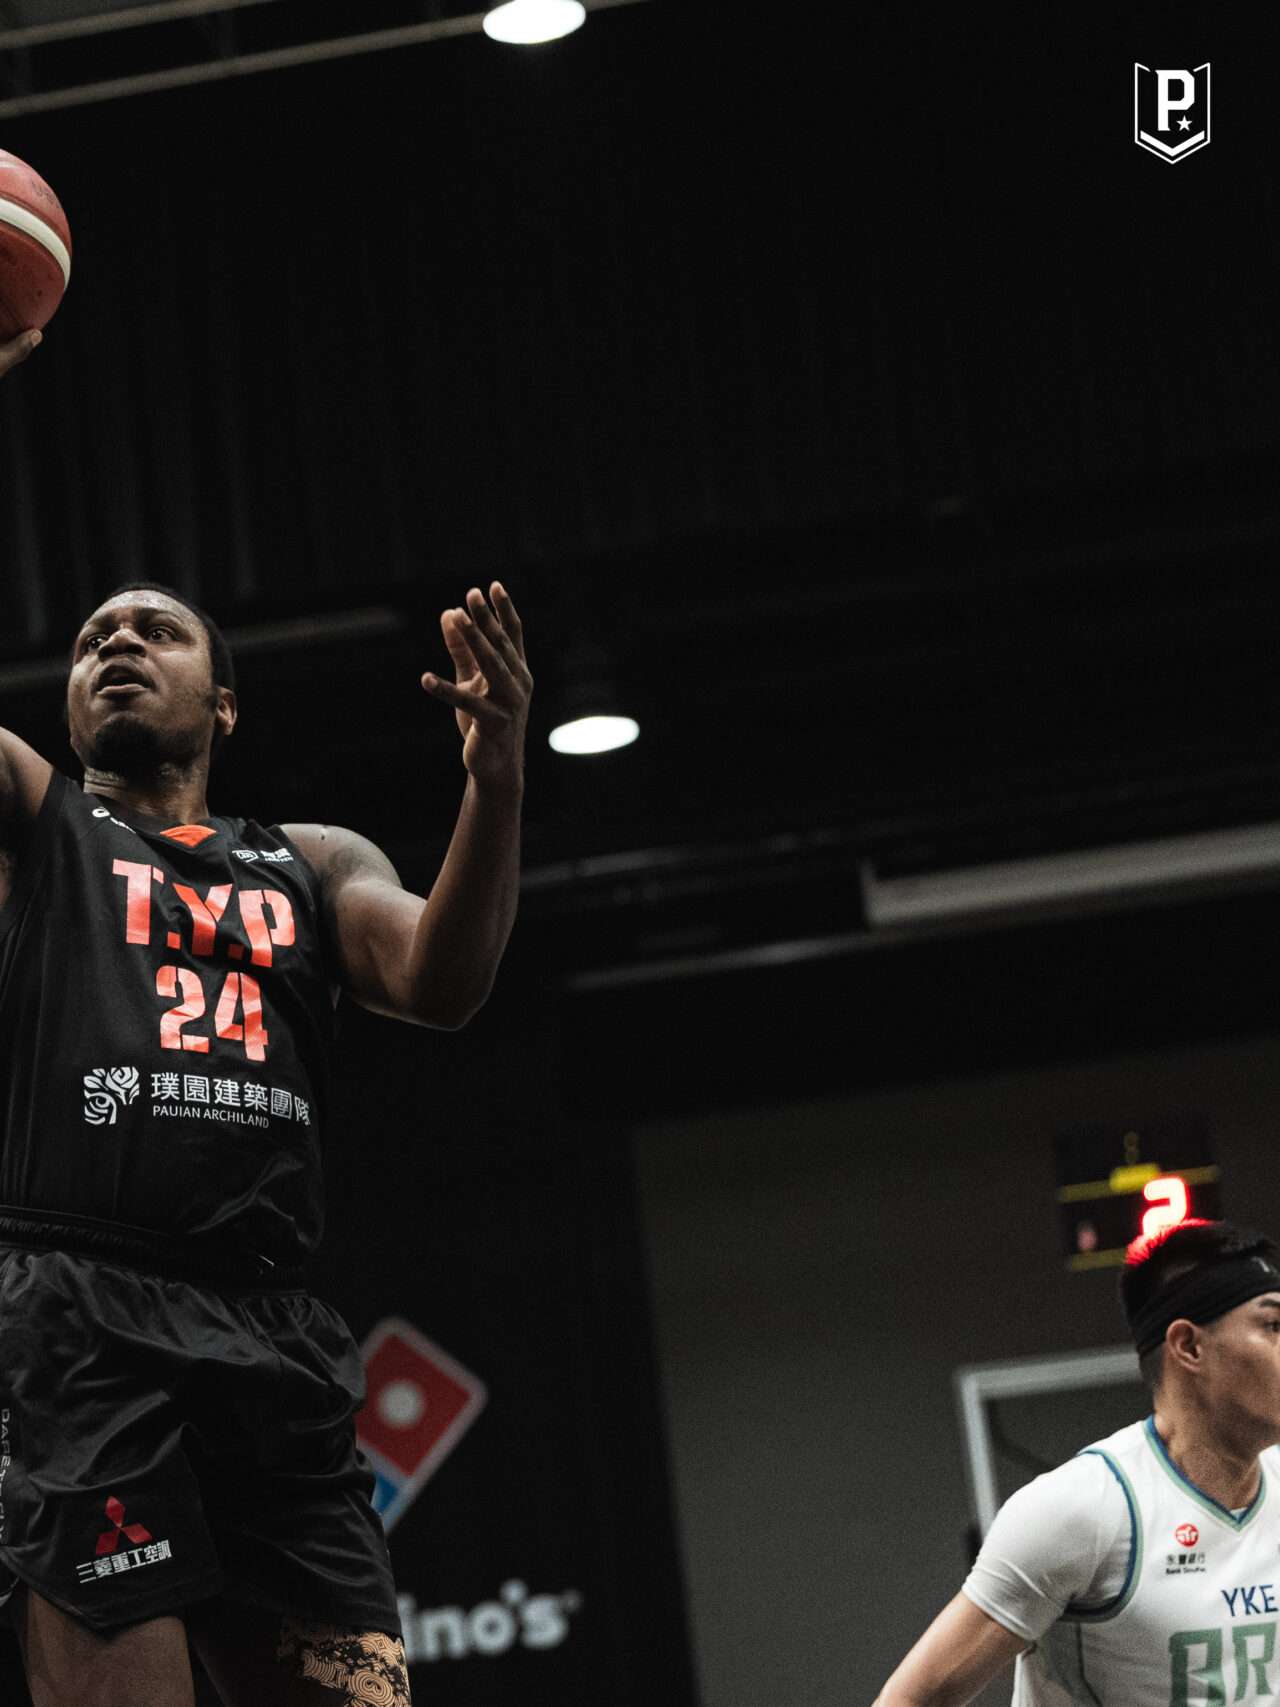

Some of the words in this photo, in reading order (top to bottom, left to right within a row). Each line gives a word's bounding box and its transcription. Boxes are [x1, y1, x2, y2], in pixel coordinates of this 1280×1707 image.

[155, 964, 269, 1062] 24
[150, 1071, 311, 1126] 璞園建築團隊
[152, 1104, 201, 1119] PAUIAN
[203, 1108, 270, 1129] ARCHILAND
[1141, 1177, 1188, 1241] 2
[75, 1539, 173, 1585] 三菱重工空調
[1221, 1584, 1279, 1617] YKE
